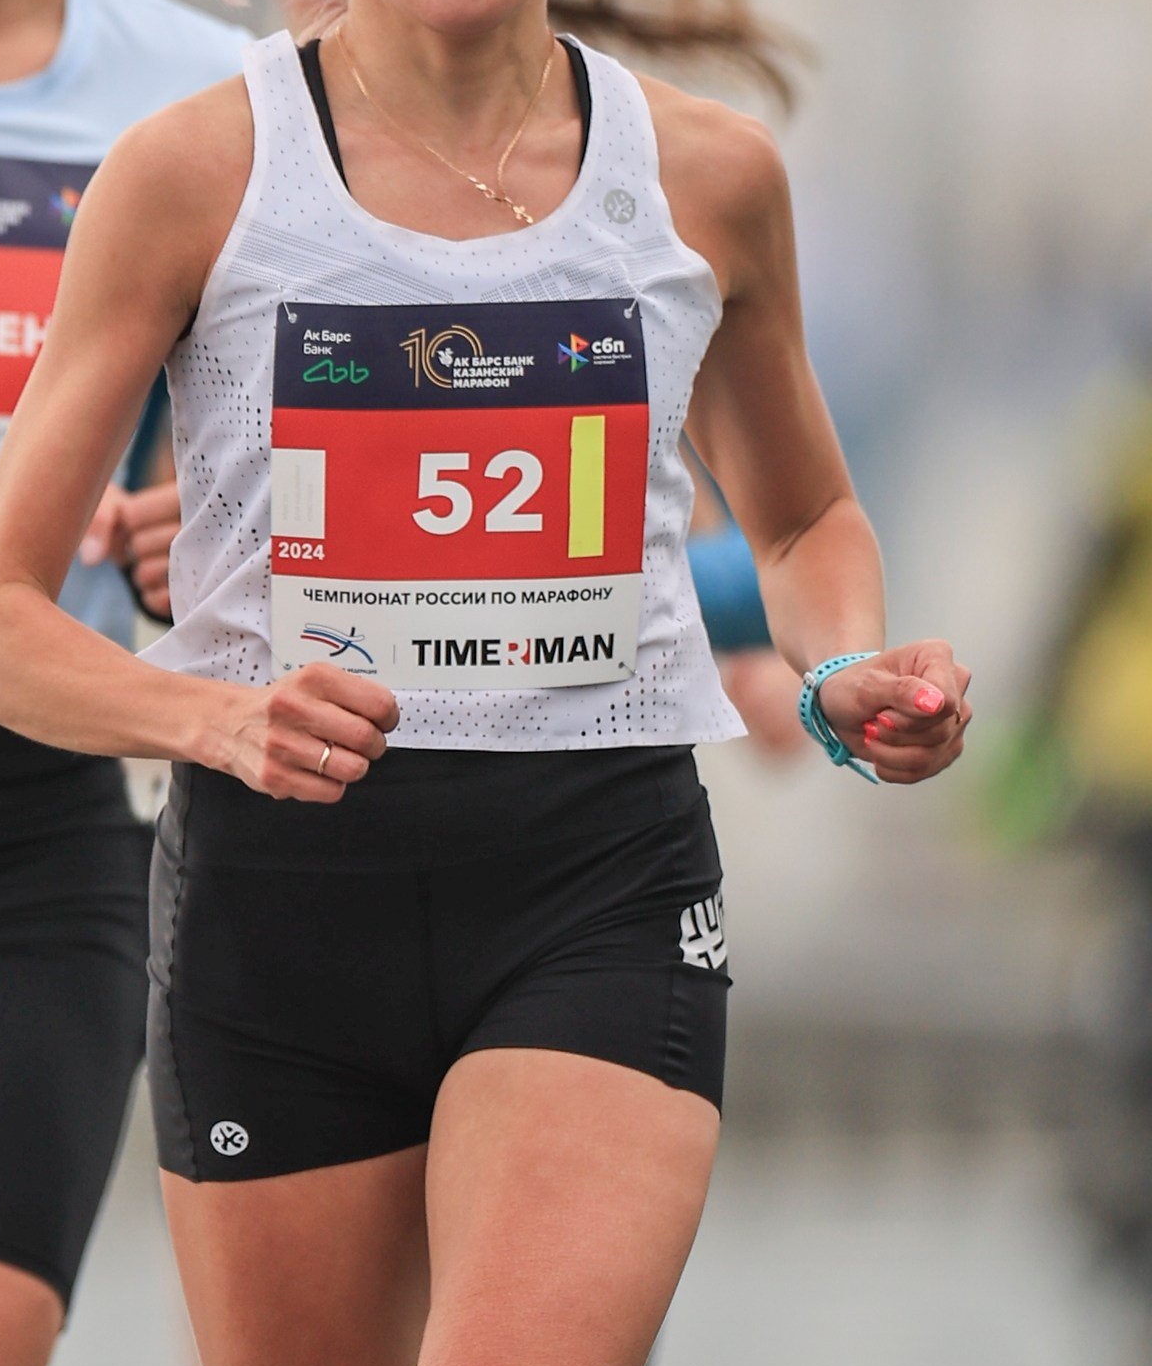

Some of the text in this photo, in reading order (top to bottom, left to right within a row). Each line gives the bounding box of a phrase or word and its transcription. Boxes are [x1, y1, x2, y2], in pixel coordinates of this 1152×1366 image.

[303, 329, 352, 344] Ак Барс
[303, 343, 332, 355] Банк
[591, 337, 625, 354] сбп
[453, 356, 535, 367] АК БАРС БАНК
[453, 366, 525, 378] КАЗАНСКИЙ
[453, 378, 510, 388] МАРАФОН
[411, 449, 544, 535] 52
[278, 541, 325, 560] 2024
[303, 587, 614, 606] ЧЕМПИОНАТ РОССИИ ПО МАРАФОНУ
[411, 633, 615, 667] TIMERMAN
